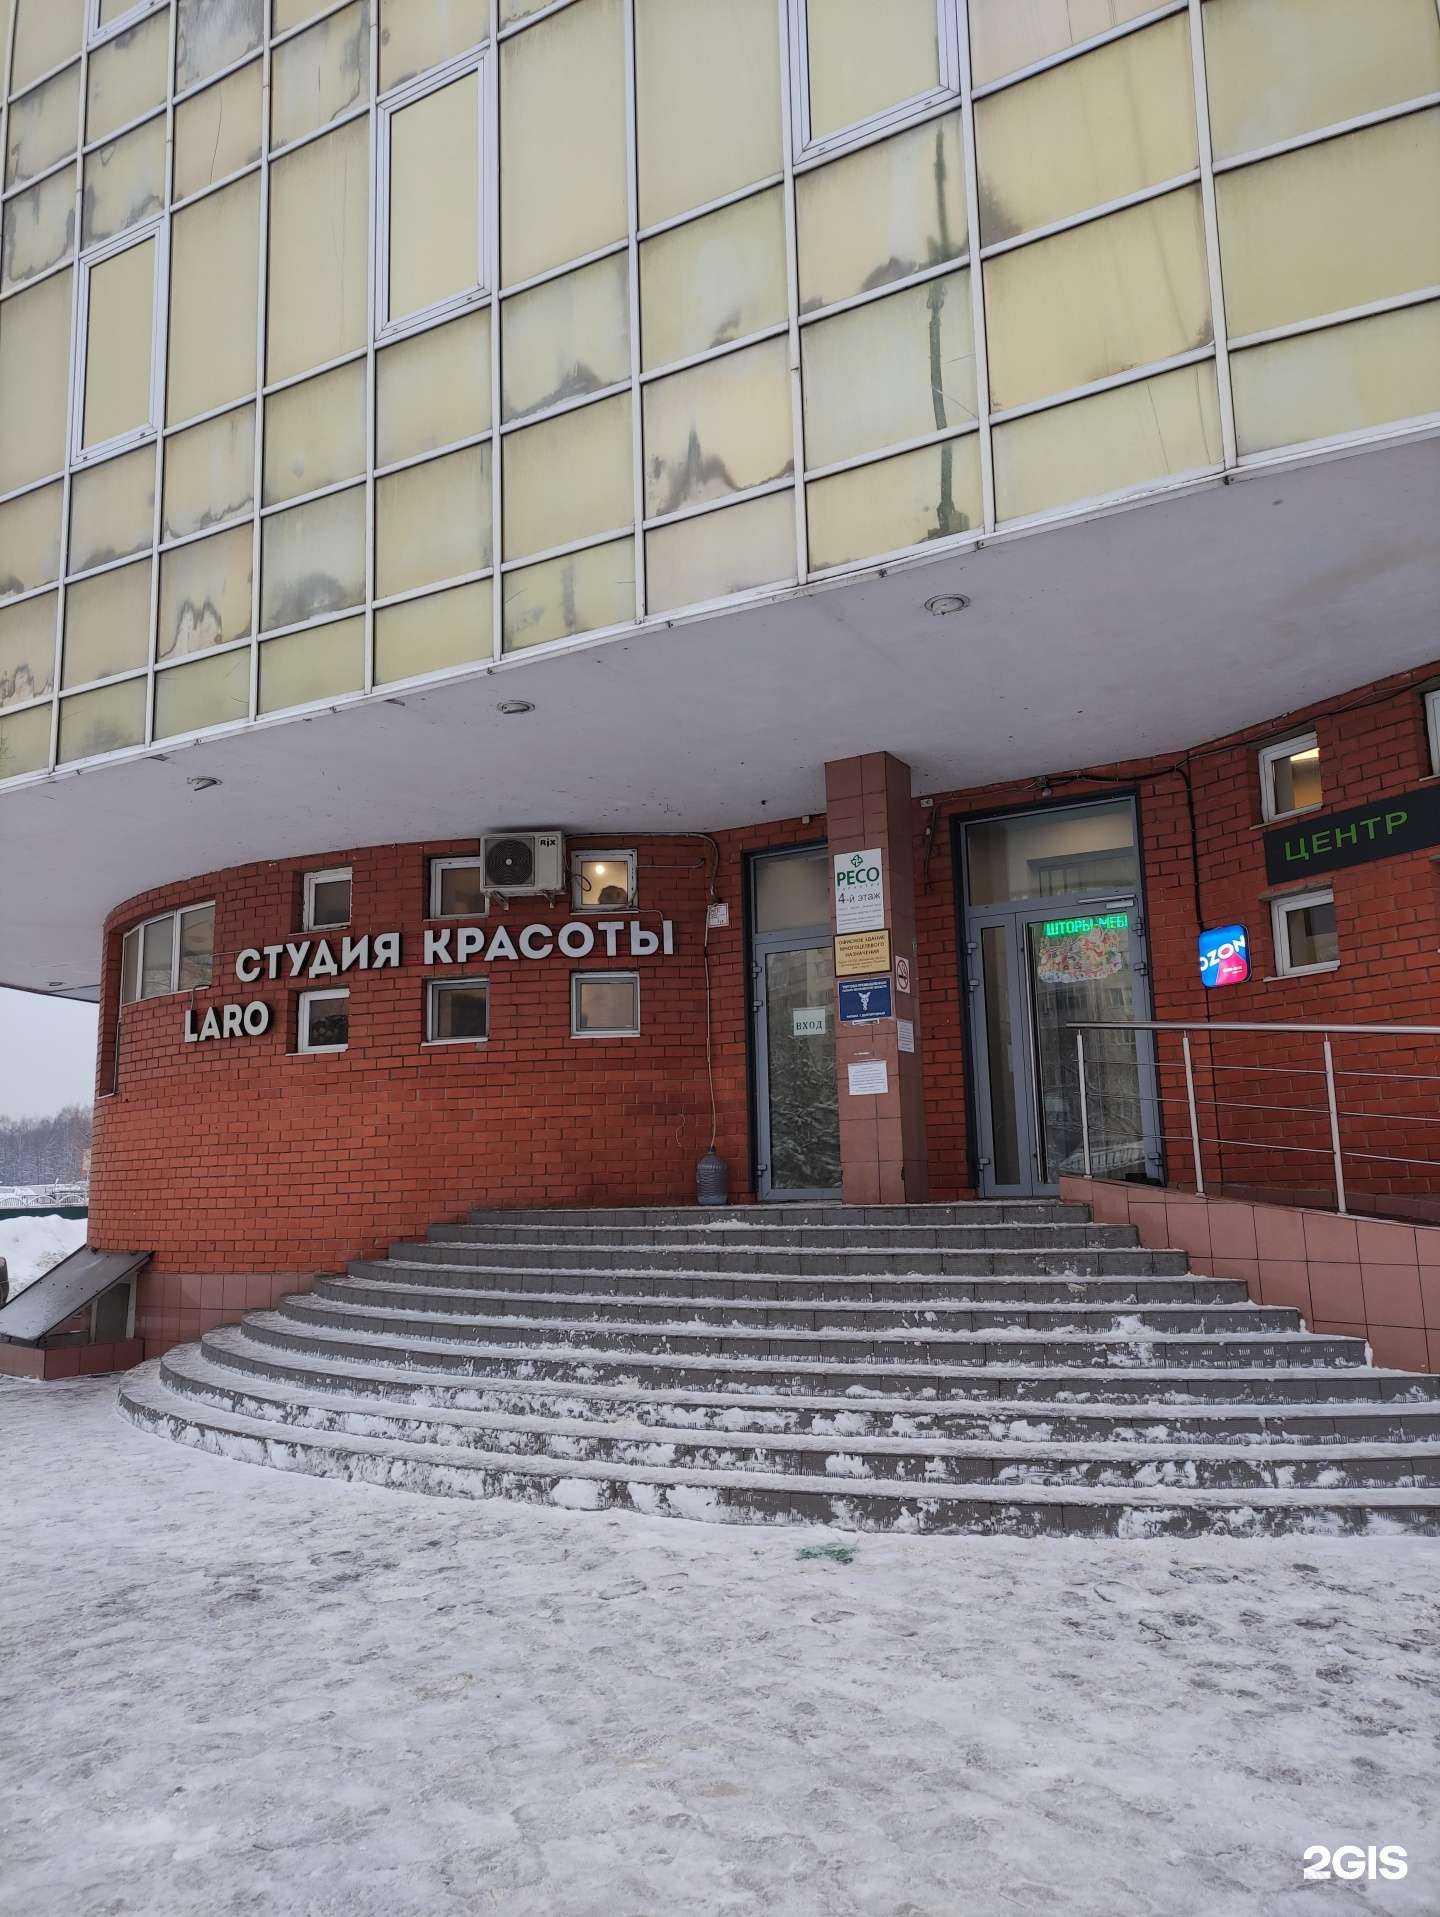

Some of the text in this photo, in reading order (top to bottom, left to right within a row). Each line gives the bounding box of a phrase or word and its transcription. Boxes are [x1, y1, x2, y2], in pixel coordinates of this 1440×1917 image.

[1284, 811, 1408, 861] ЦЕНТР
[836, 867, 880, 887] РЕСО
[838, 892, 881, 904] 4-й этаж
[1045, 918, 1093, 936] ШТОРЫ
[235, 920, 674, 983] СТУДИЯ КРАСОТЫ
[184, 1000, 269, 1043] LARO
[796, 1020, 824, 1031] ВХОД
